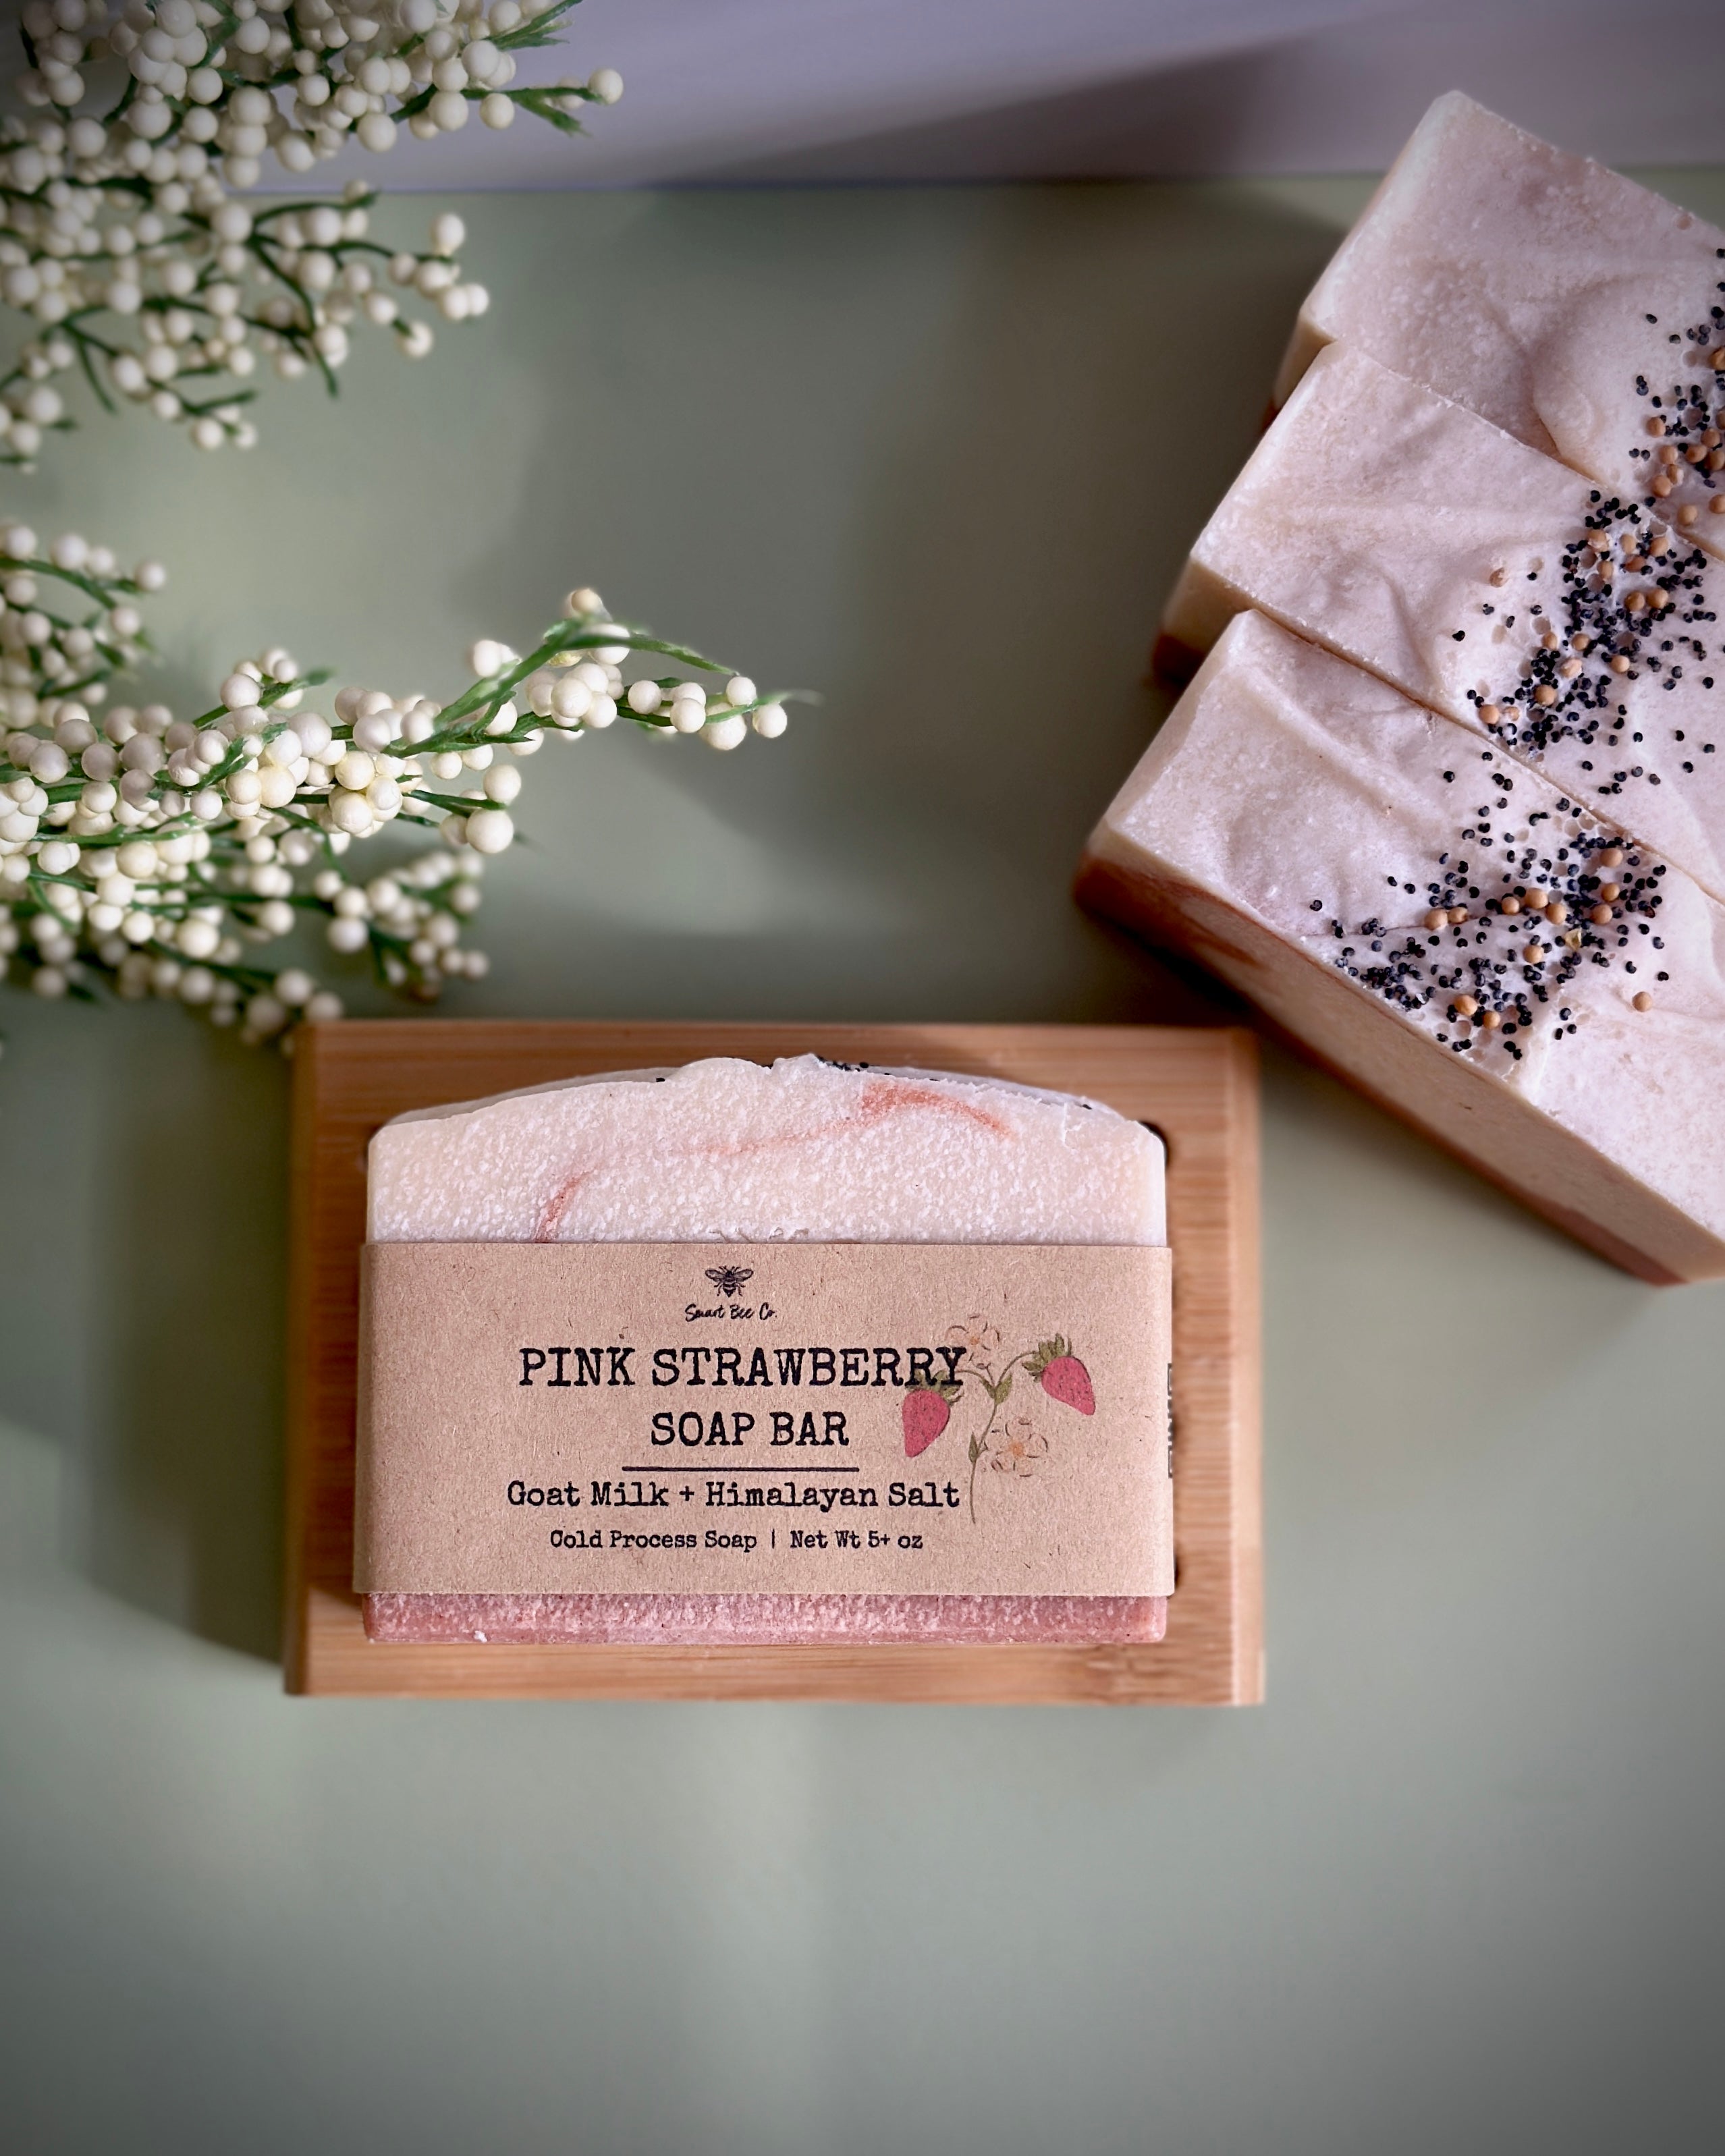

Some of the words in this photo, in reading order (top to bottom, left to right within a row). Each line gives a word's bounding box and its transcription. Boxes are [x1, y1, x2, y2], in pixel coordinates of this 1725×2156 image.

[729, 1303, 755, 1320] Bee
[518, 1346, 636, 1387] PINK
[651, 1346, 967, 1387] STRAWBERRY
[651, 1411, 755, 1447] SOAP
[769, 1410, 850, 1446] BAR
[508, 1480, 580, 1508] Goat
[590, 1481, 669, 1507] Milk
[705, 1481, 879, 1513] Himalayan
[888, 1481, 960, 1508] Salt
[550, 1529, 603, 1549] Cold
[609, 1529, 698, 1549] Process
[705, 1530, 758, 1553] Soap
[790, 1529, 829, 1549] Net
[833, 1530, 861, 1549] Wt
[867, 1530, 891, 1548] 5+
[897, 1535, 923, 1549] oz
